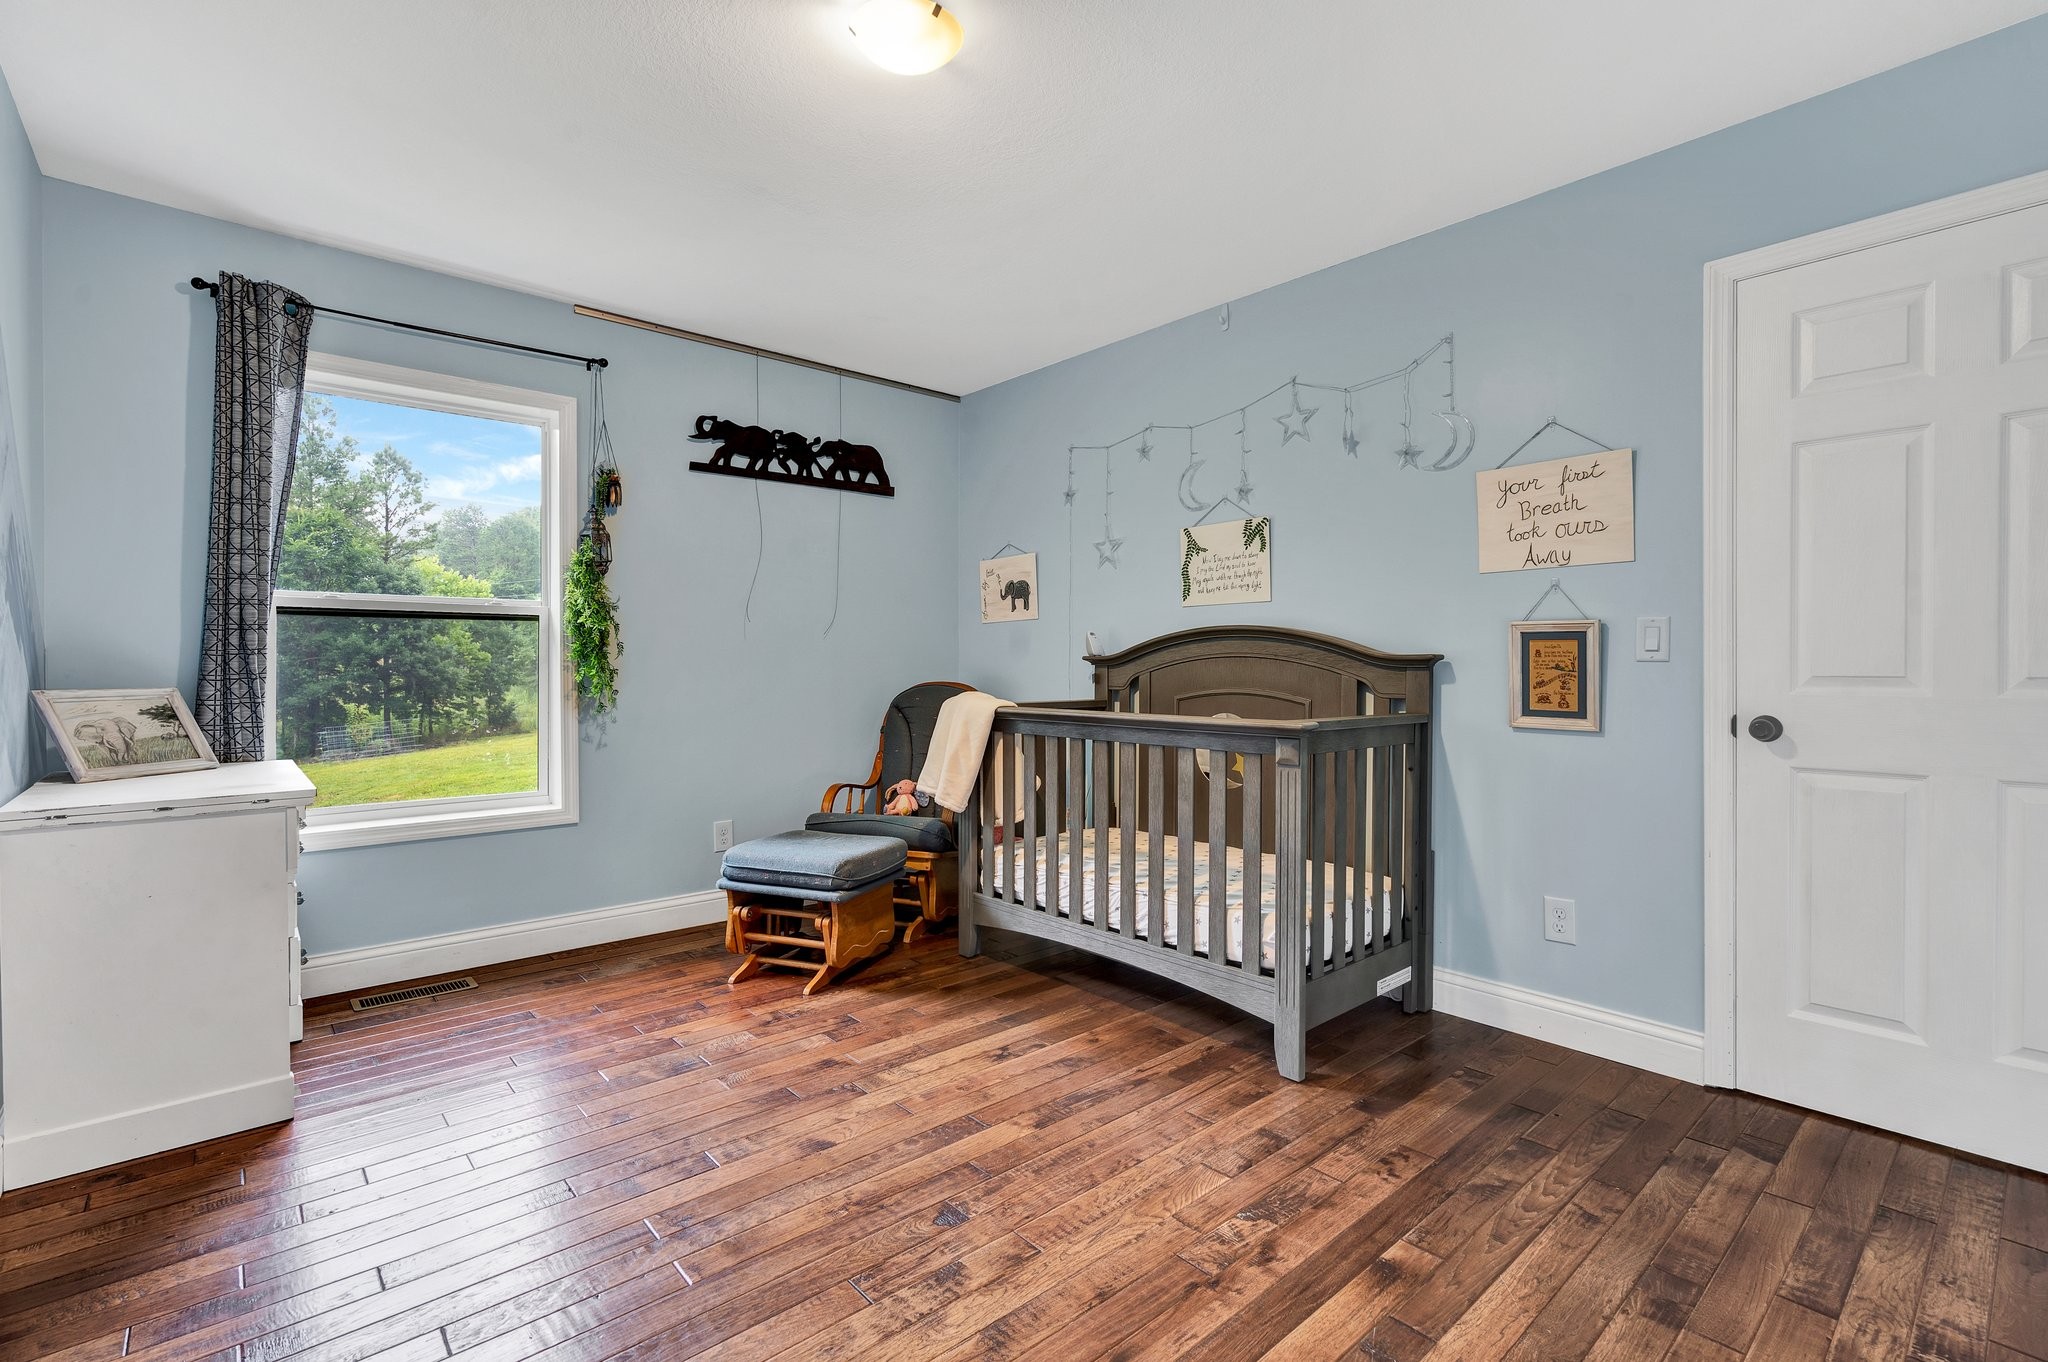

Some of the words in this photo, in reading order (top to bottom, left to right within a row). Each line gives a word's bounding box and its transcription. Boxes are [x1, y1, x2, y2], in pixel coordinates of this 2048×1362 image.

[1558, 460, 1606, 496] first
[1518, 493, 1588, 521] Breath
[1507, 520, 1548, 542] took
[1555, 519, 1609, 539] ours
[1522, 543, 1572, 568] Away
